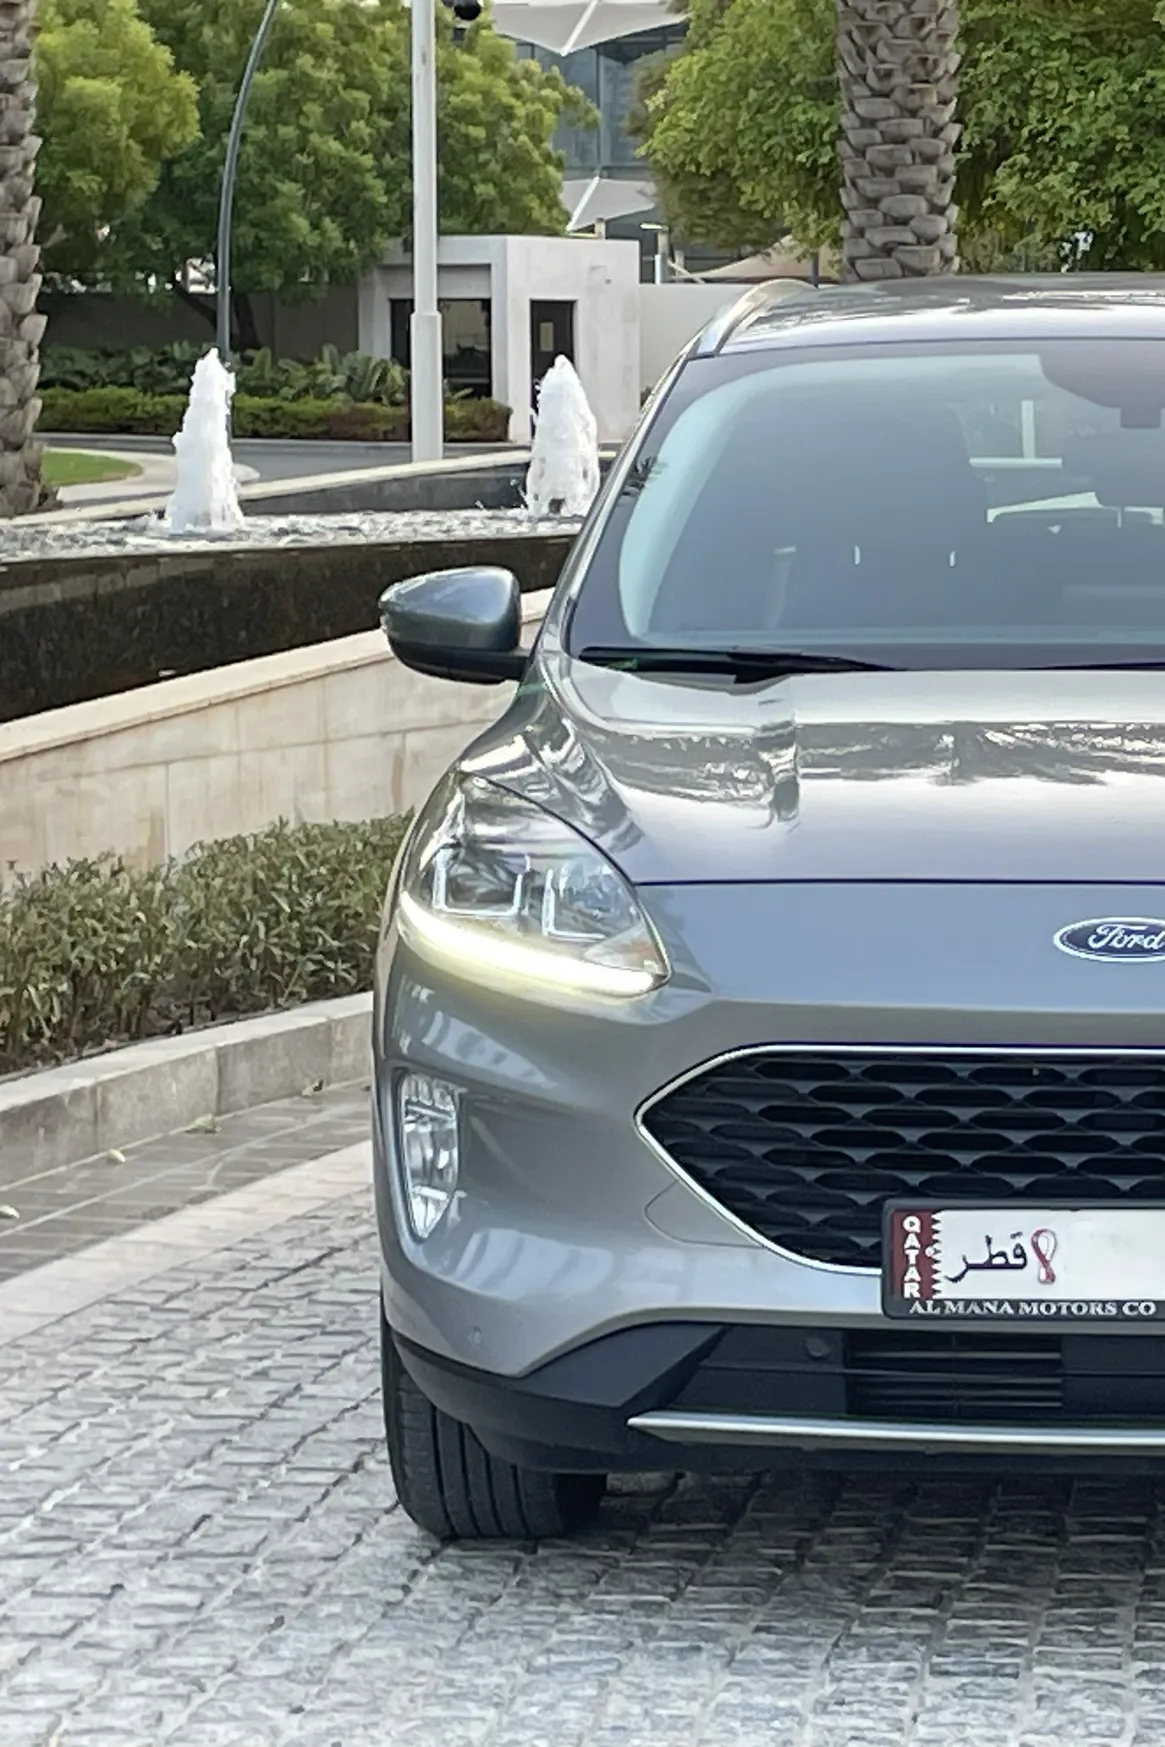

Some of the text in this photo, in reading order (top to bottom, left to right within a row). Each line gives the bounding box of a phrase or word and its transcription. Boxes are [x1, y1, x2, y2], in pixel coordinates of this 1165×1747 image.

[902, 1215, 922, 1299] QATAR
[944, 1231, 1028, 1284] قطر
[909, 1301, 1157, 1317] AL MANA MOTORS CO
